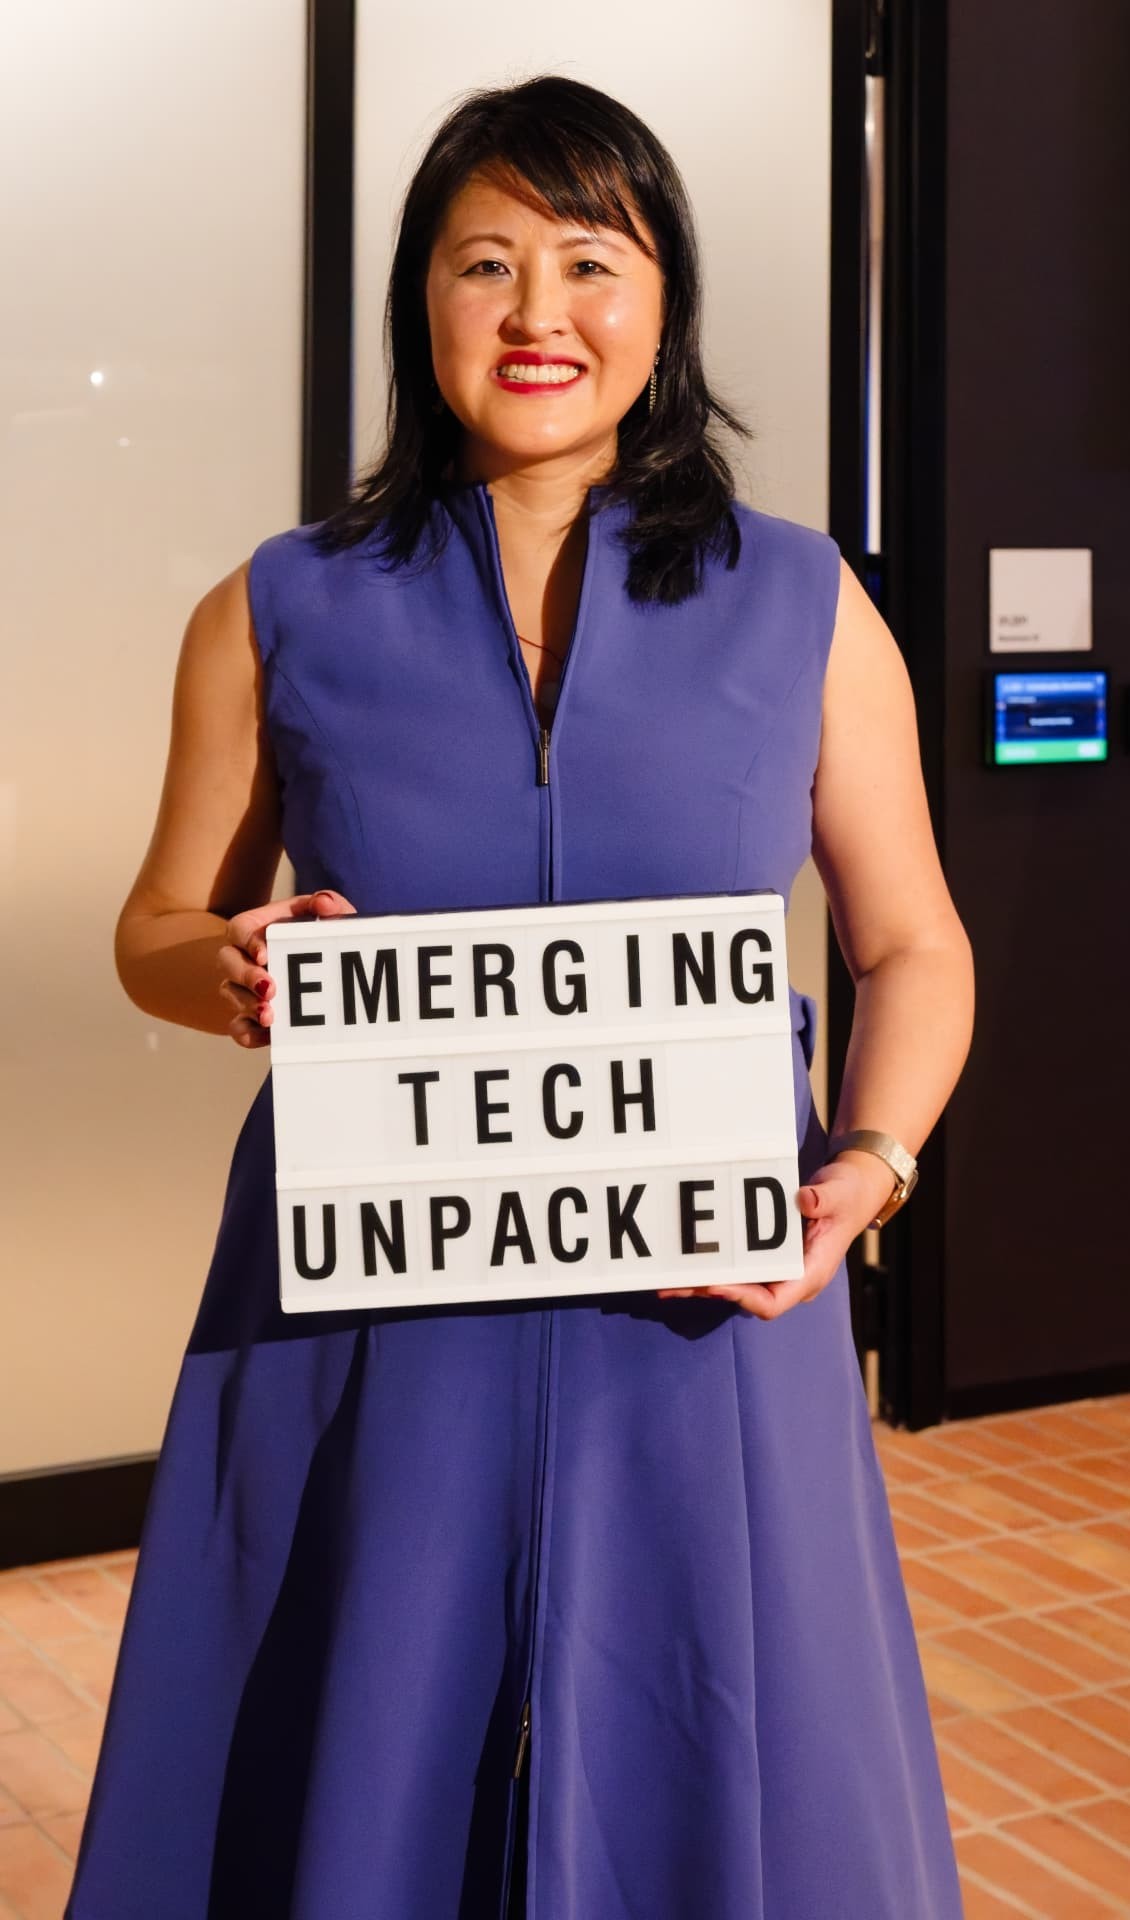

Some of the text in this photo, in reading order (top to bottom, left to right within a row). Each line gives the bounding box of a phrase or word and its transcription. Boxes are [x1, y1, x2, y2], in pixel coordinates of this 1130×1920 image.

[287, 928, 775, 1027] EMERGING
[397, 1058, 656, 1145] TECH
[292, 1176, 788, 1280] UNPACKED
